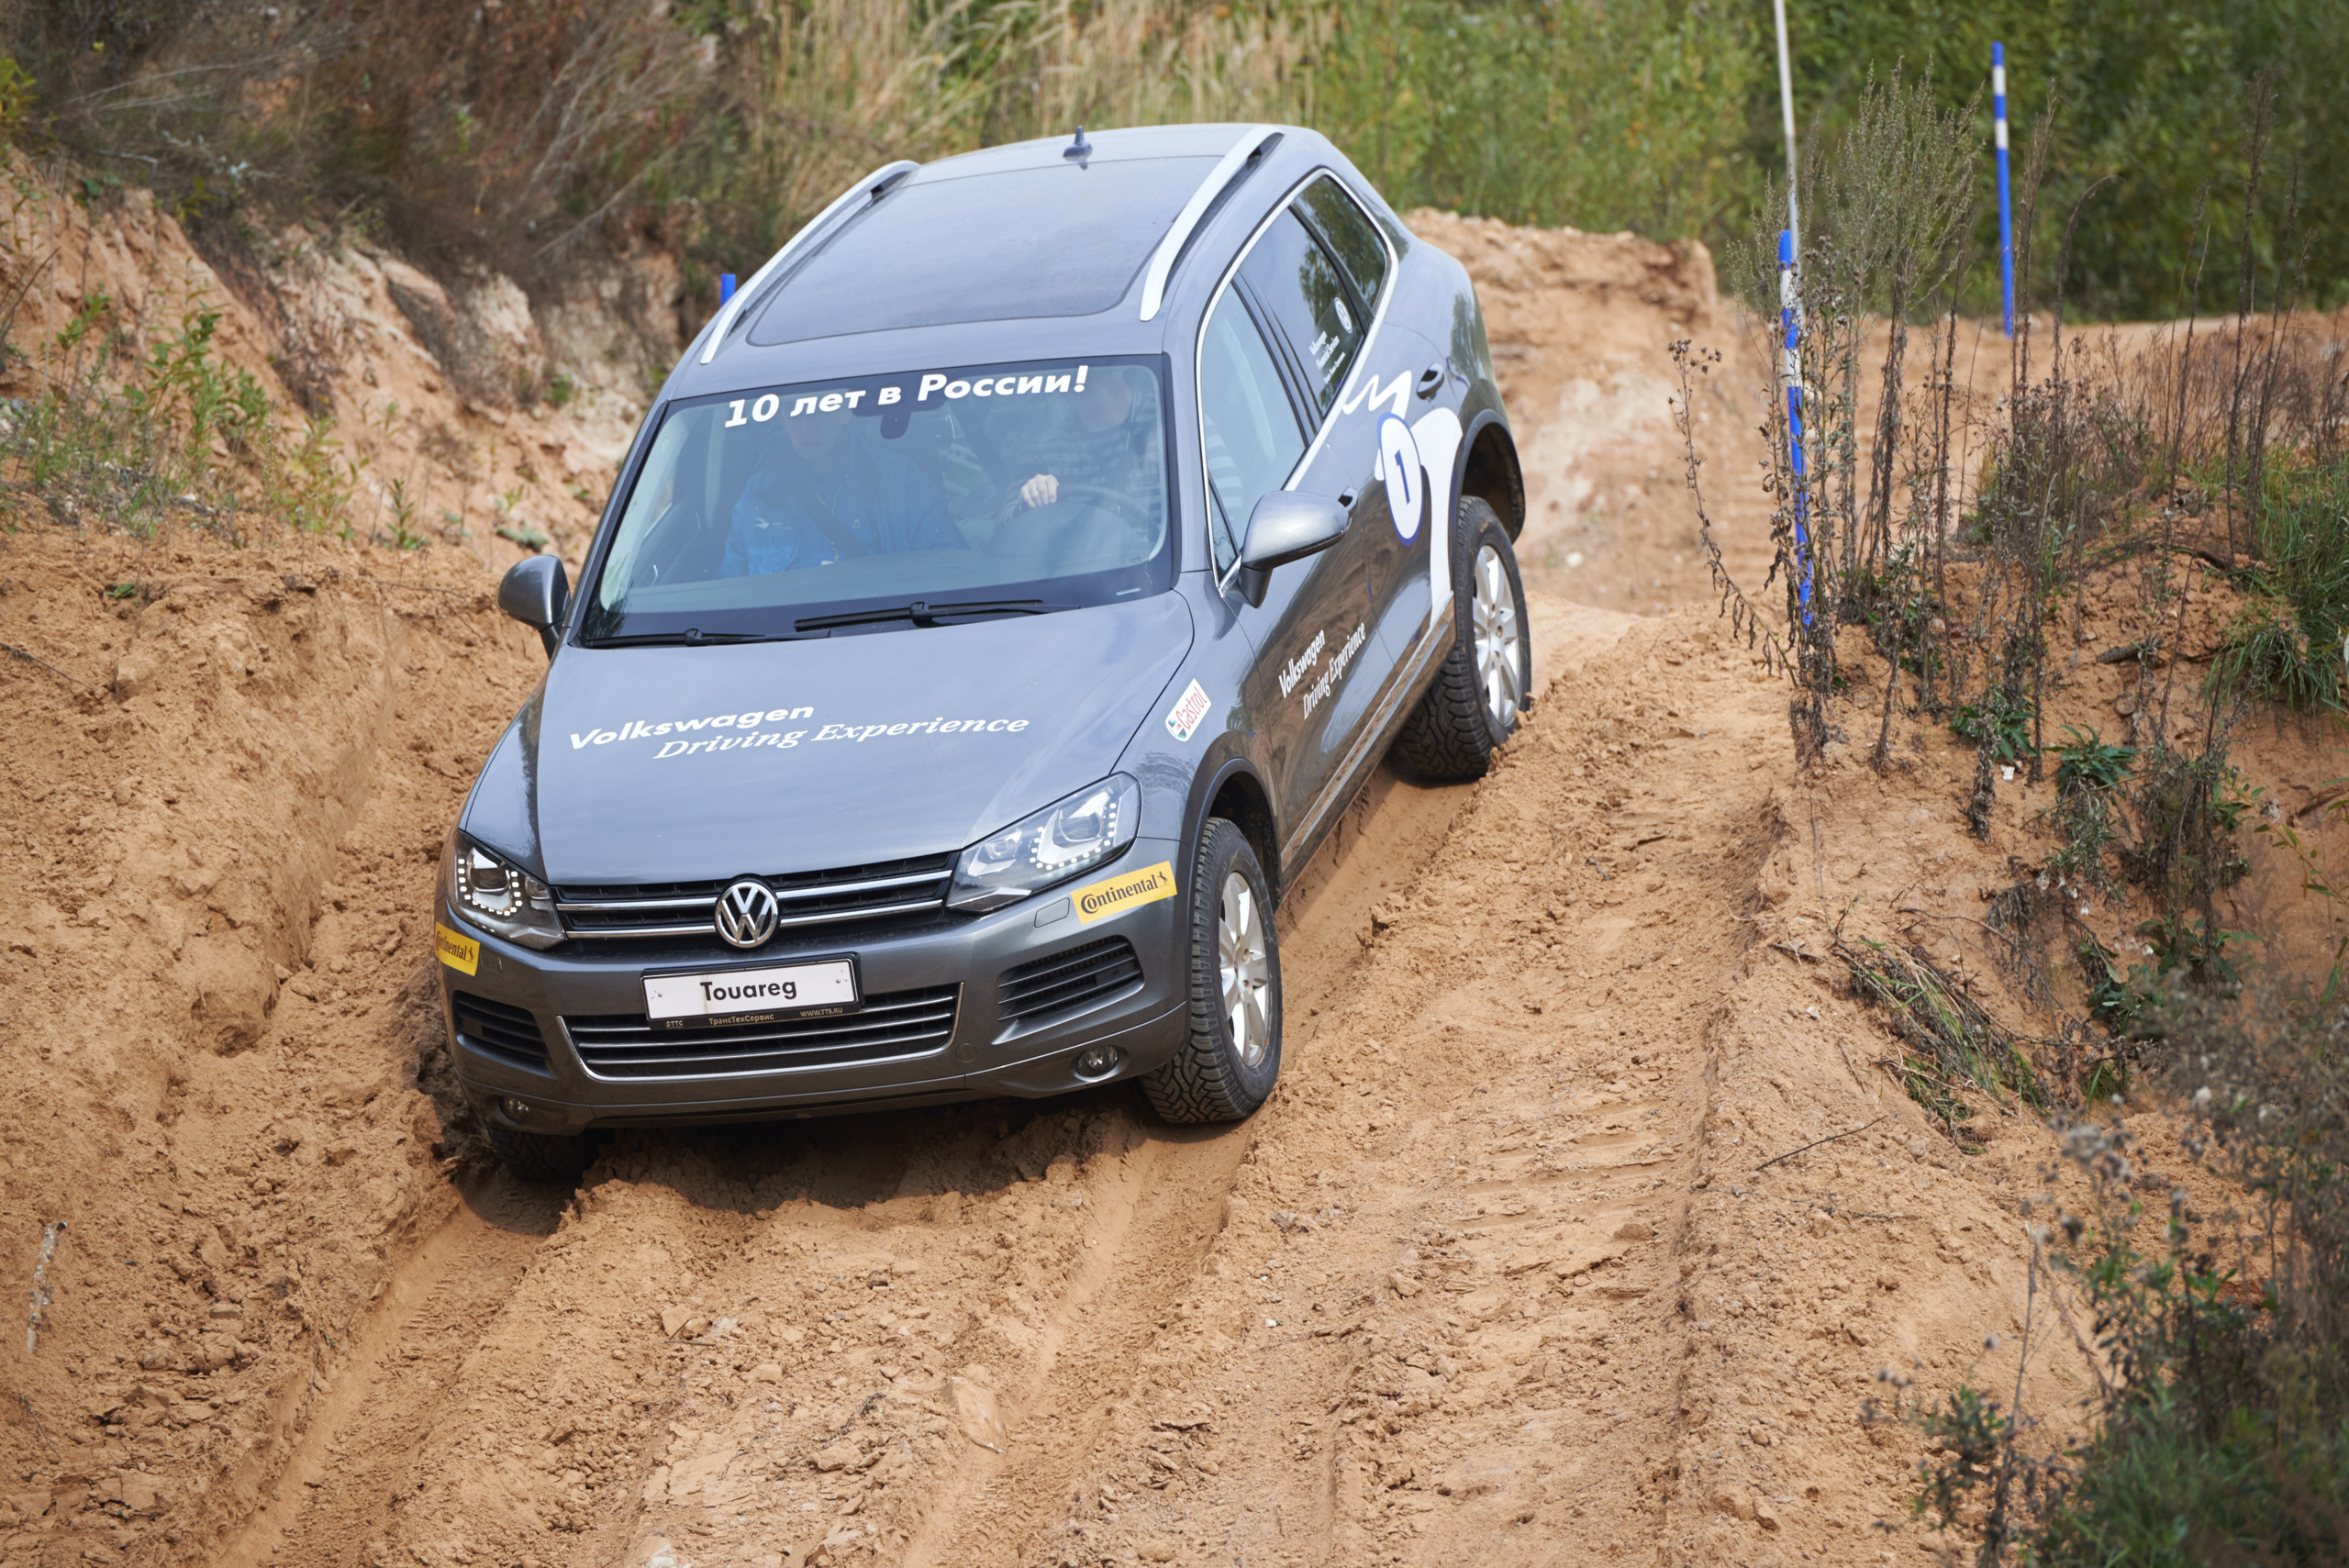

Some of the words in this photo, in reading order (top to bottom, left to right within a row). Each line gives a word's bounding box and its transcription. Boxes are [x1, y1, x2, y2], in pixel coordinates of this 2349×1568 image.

[725, 394, 780, 428] 10
[790, 390, 867, 417] лет
[878, 386, 902, 406] в
[918, 365, 1089, 402] России!
[1394, 450, 1410, 506] 1
[1278, 629, 1325, 698] Volkswagen
[1303, 671, 1330, 719] Driving
[1329, 622, 1365, 683] Experience
[569, 706, 814, 751] Volkswagen
[1175, 685, 1208, 730] Castrol
[652, 728, 807, 760] Driving
[810, 716, 1030, 743] Experience
[1080, 873, 1158, 915] Continental
[700, 981, 797, 1002] Touareg
[708, 1014, 774, 1026] ТрансТехСервис
